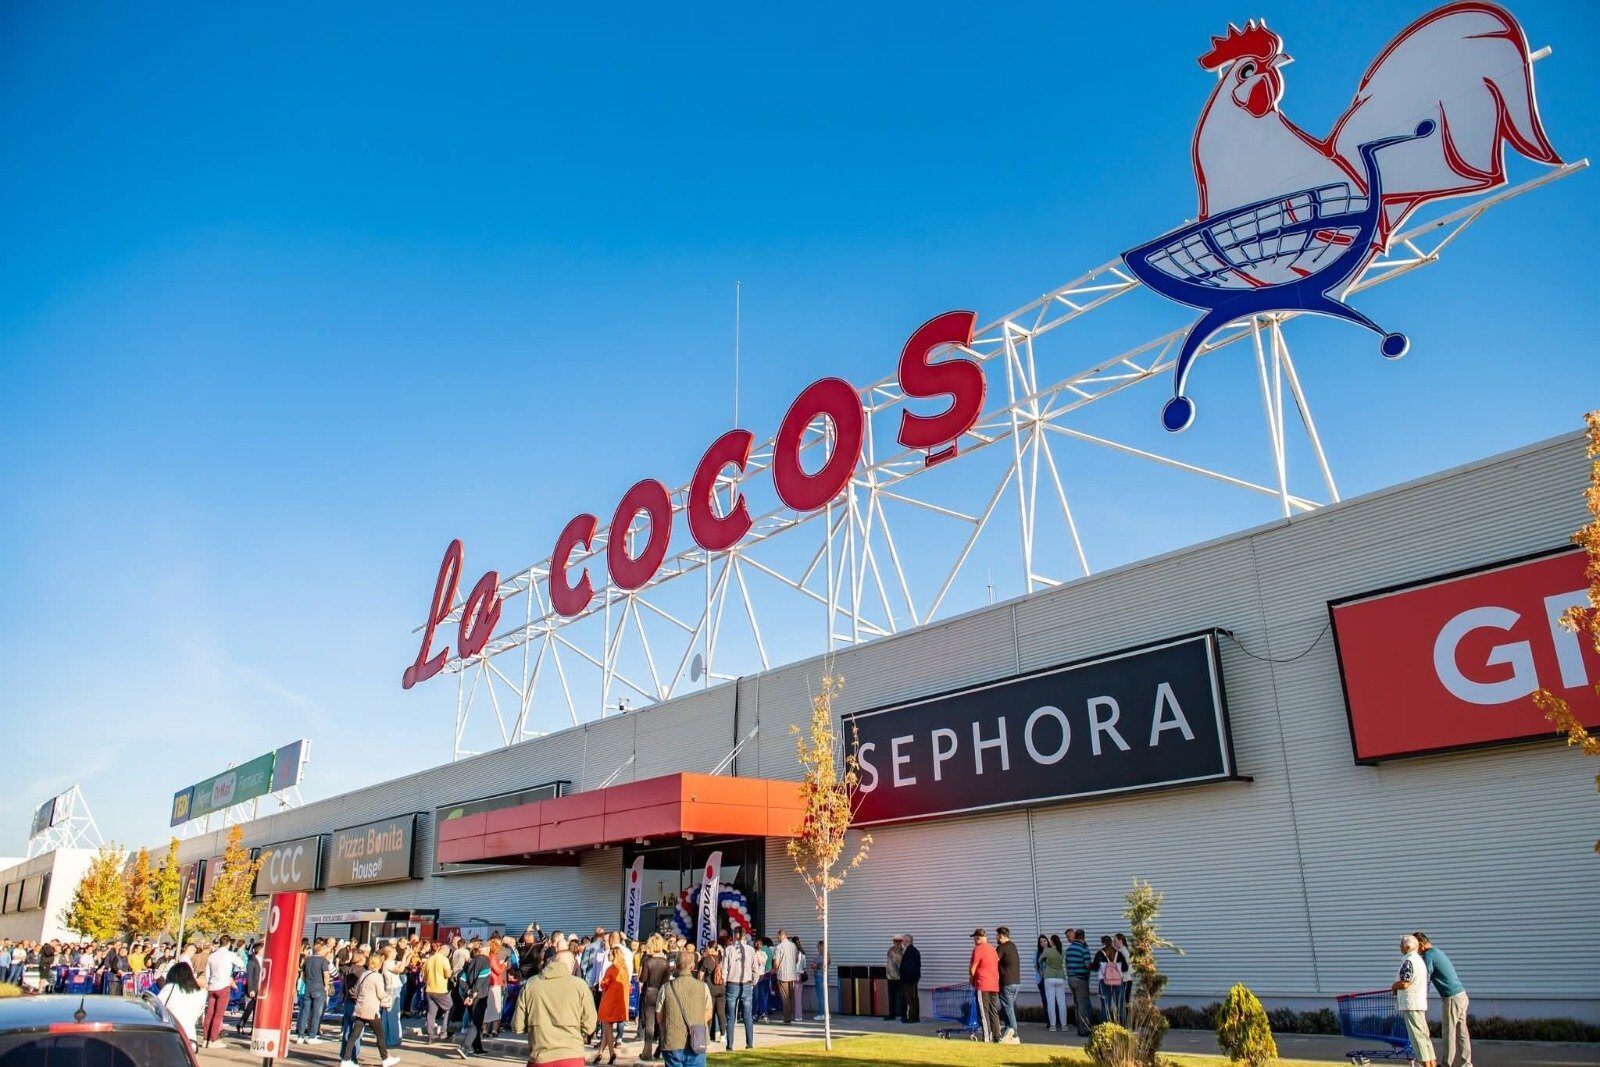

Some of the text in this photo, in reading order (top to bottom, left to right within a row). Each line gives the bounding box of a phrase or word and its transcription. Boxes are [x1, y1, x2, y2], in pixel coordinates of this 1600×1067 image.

[402, 539, 501, 689] La
[858, 682, 1195, 793] SEPHORA
[269, 845, 304, 885] CCC
[338, 824, 403, 860] Pizza Bonita
